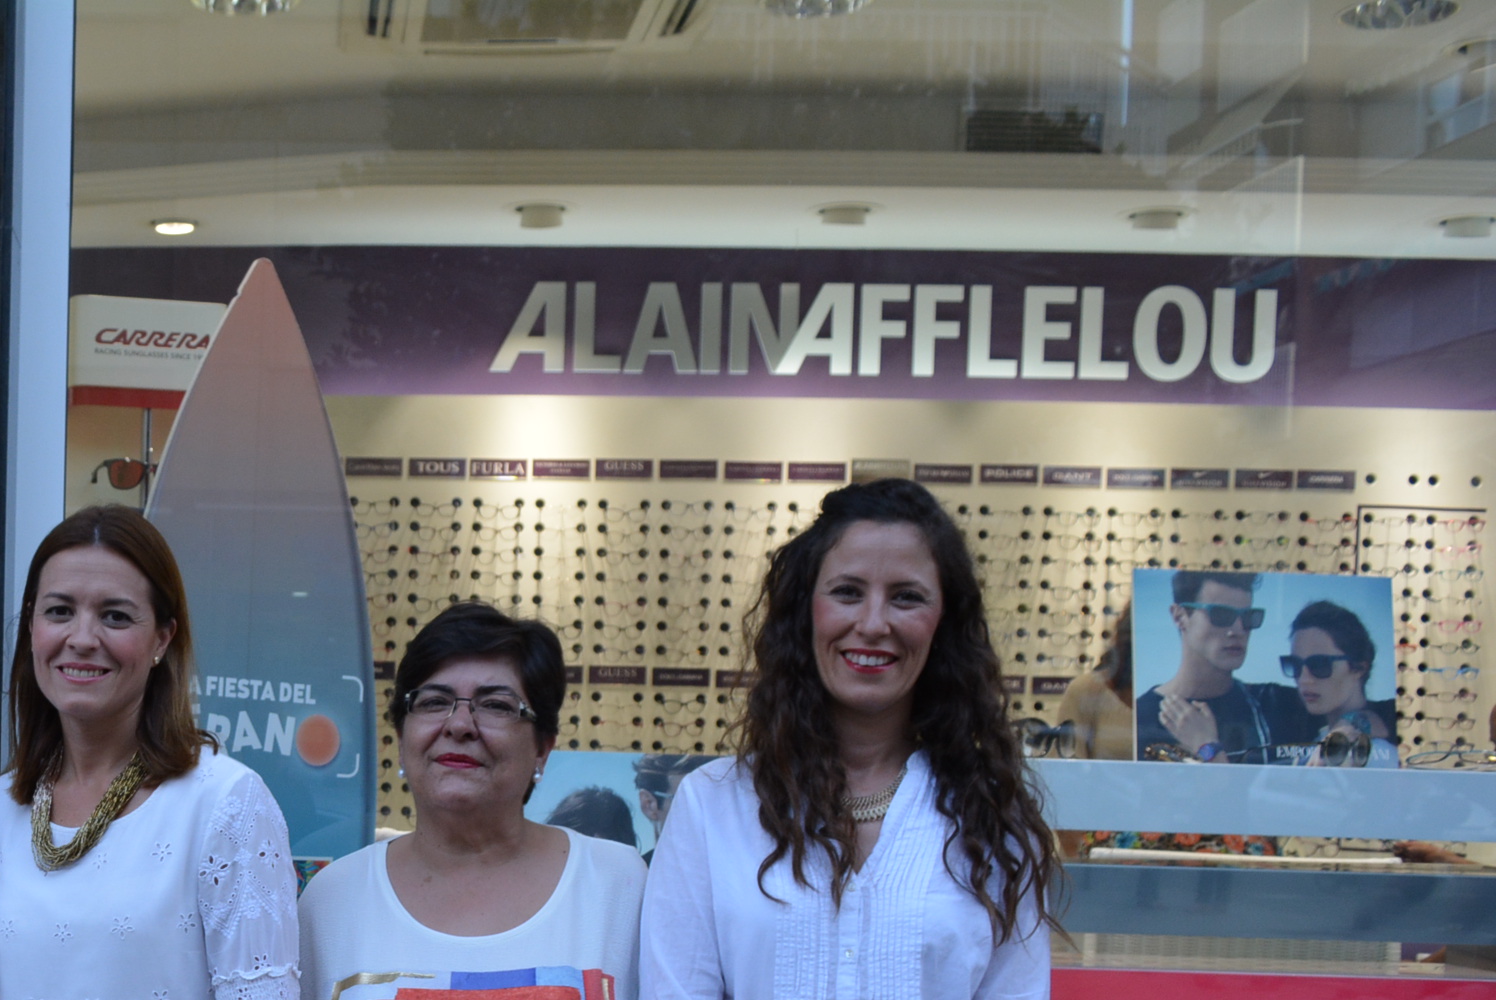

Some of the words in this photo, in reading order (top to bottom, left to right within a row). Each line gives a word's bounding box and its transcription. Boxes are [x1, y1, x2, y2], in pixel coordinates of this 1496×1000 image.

[95, 328, 210, 350] CARRERA
[94, 347, 122, 356] RACING
[124, 349, 169, 359] SUNGLASSES
[417, 461, 460, 474] TOUS
[471, 461, 525, 475] FURLA
[605, 461, 645, 472] GUESS
[984, 468, 1035, 479] POLICE
[1052, 471, 1093, 481] GANT
[599, 668, 637, 678] GUESS
[188, 675, 202, 696] A
[206, 676, 276, 701] FIESTA
[279, 682, 316, 705] DEL
